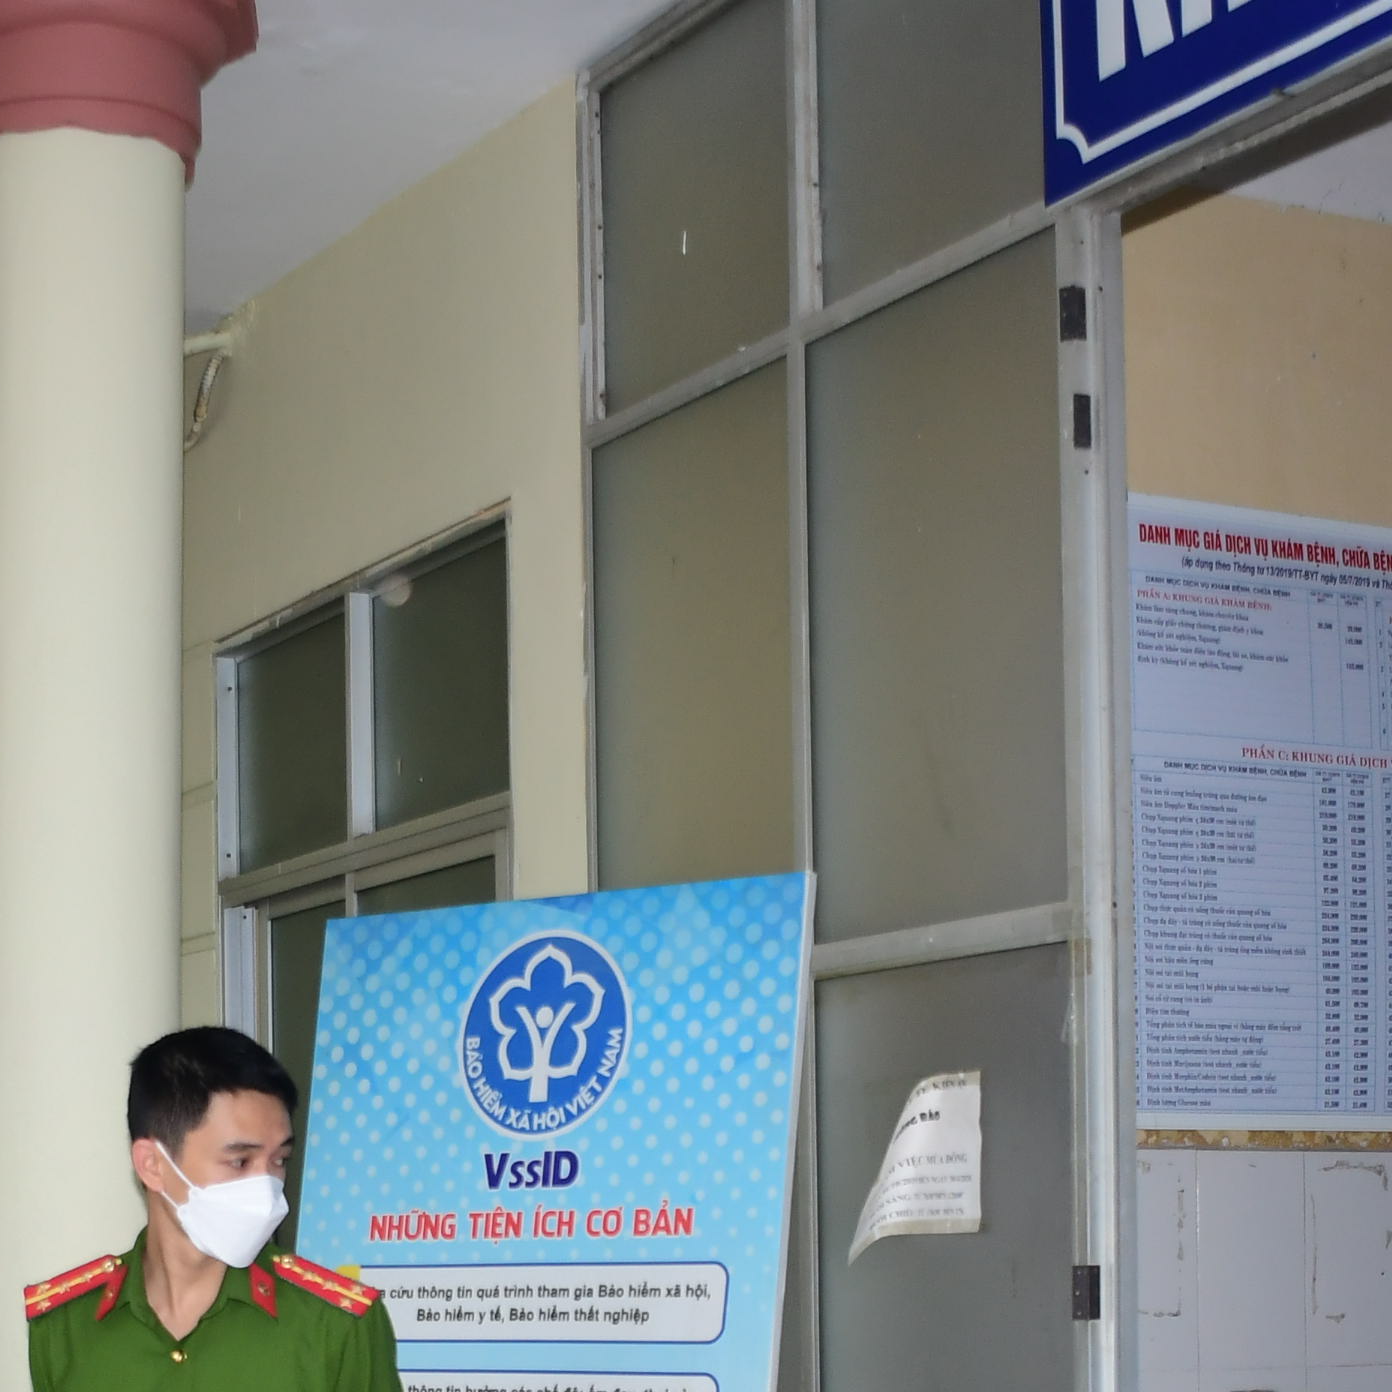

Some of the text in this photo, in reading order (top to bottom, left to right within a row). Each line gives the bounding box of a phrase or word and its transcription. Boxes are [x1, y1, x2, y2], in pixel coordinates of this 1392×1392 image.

[1138, 523, 1171, 545] DANH
[1174, 527, 1200, 552] MỤC
[1203, 529, 1222, 551] GIÁ
[1224, 534, 1251, 558] DỊCH
[1253, 537, 1268, 561] VỤ
[1270, 538, 1304, 561] KHÁM
[1306, 541, 1339, 567] BỆNH,
[1341, 545, 1370, 569] CHỮA
[1291, 751, 1333, 769] KHUNG
[466, 1028, 623, 1131] BẢO HIỂM XÃ HỘI VIỆT NAM
[484, 1150, 579, 1189] VssID
[369, 1198, 695, 1246] NHỮNG TIỆN ÍCH CƠ BẢN
[416, 1304, 650, 1325] Bảo hiểm y tế, Bảo hiểm thất nghiệp
